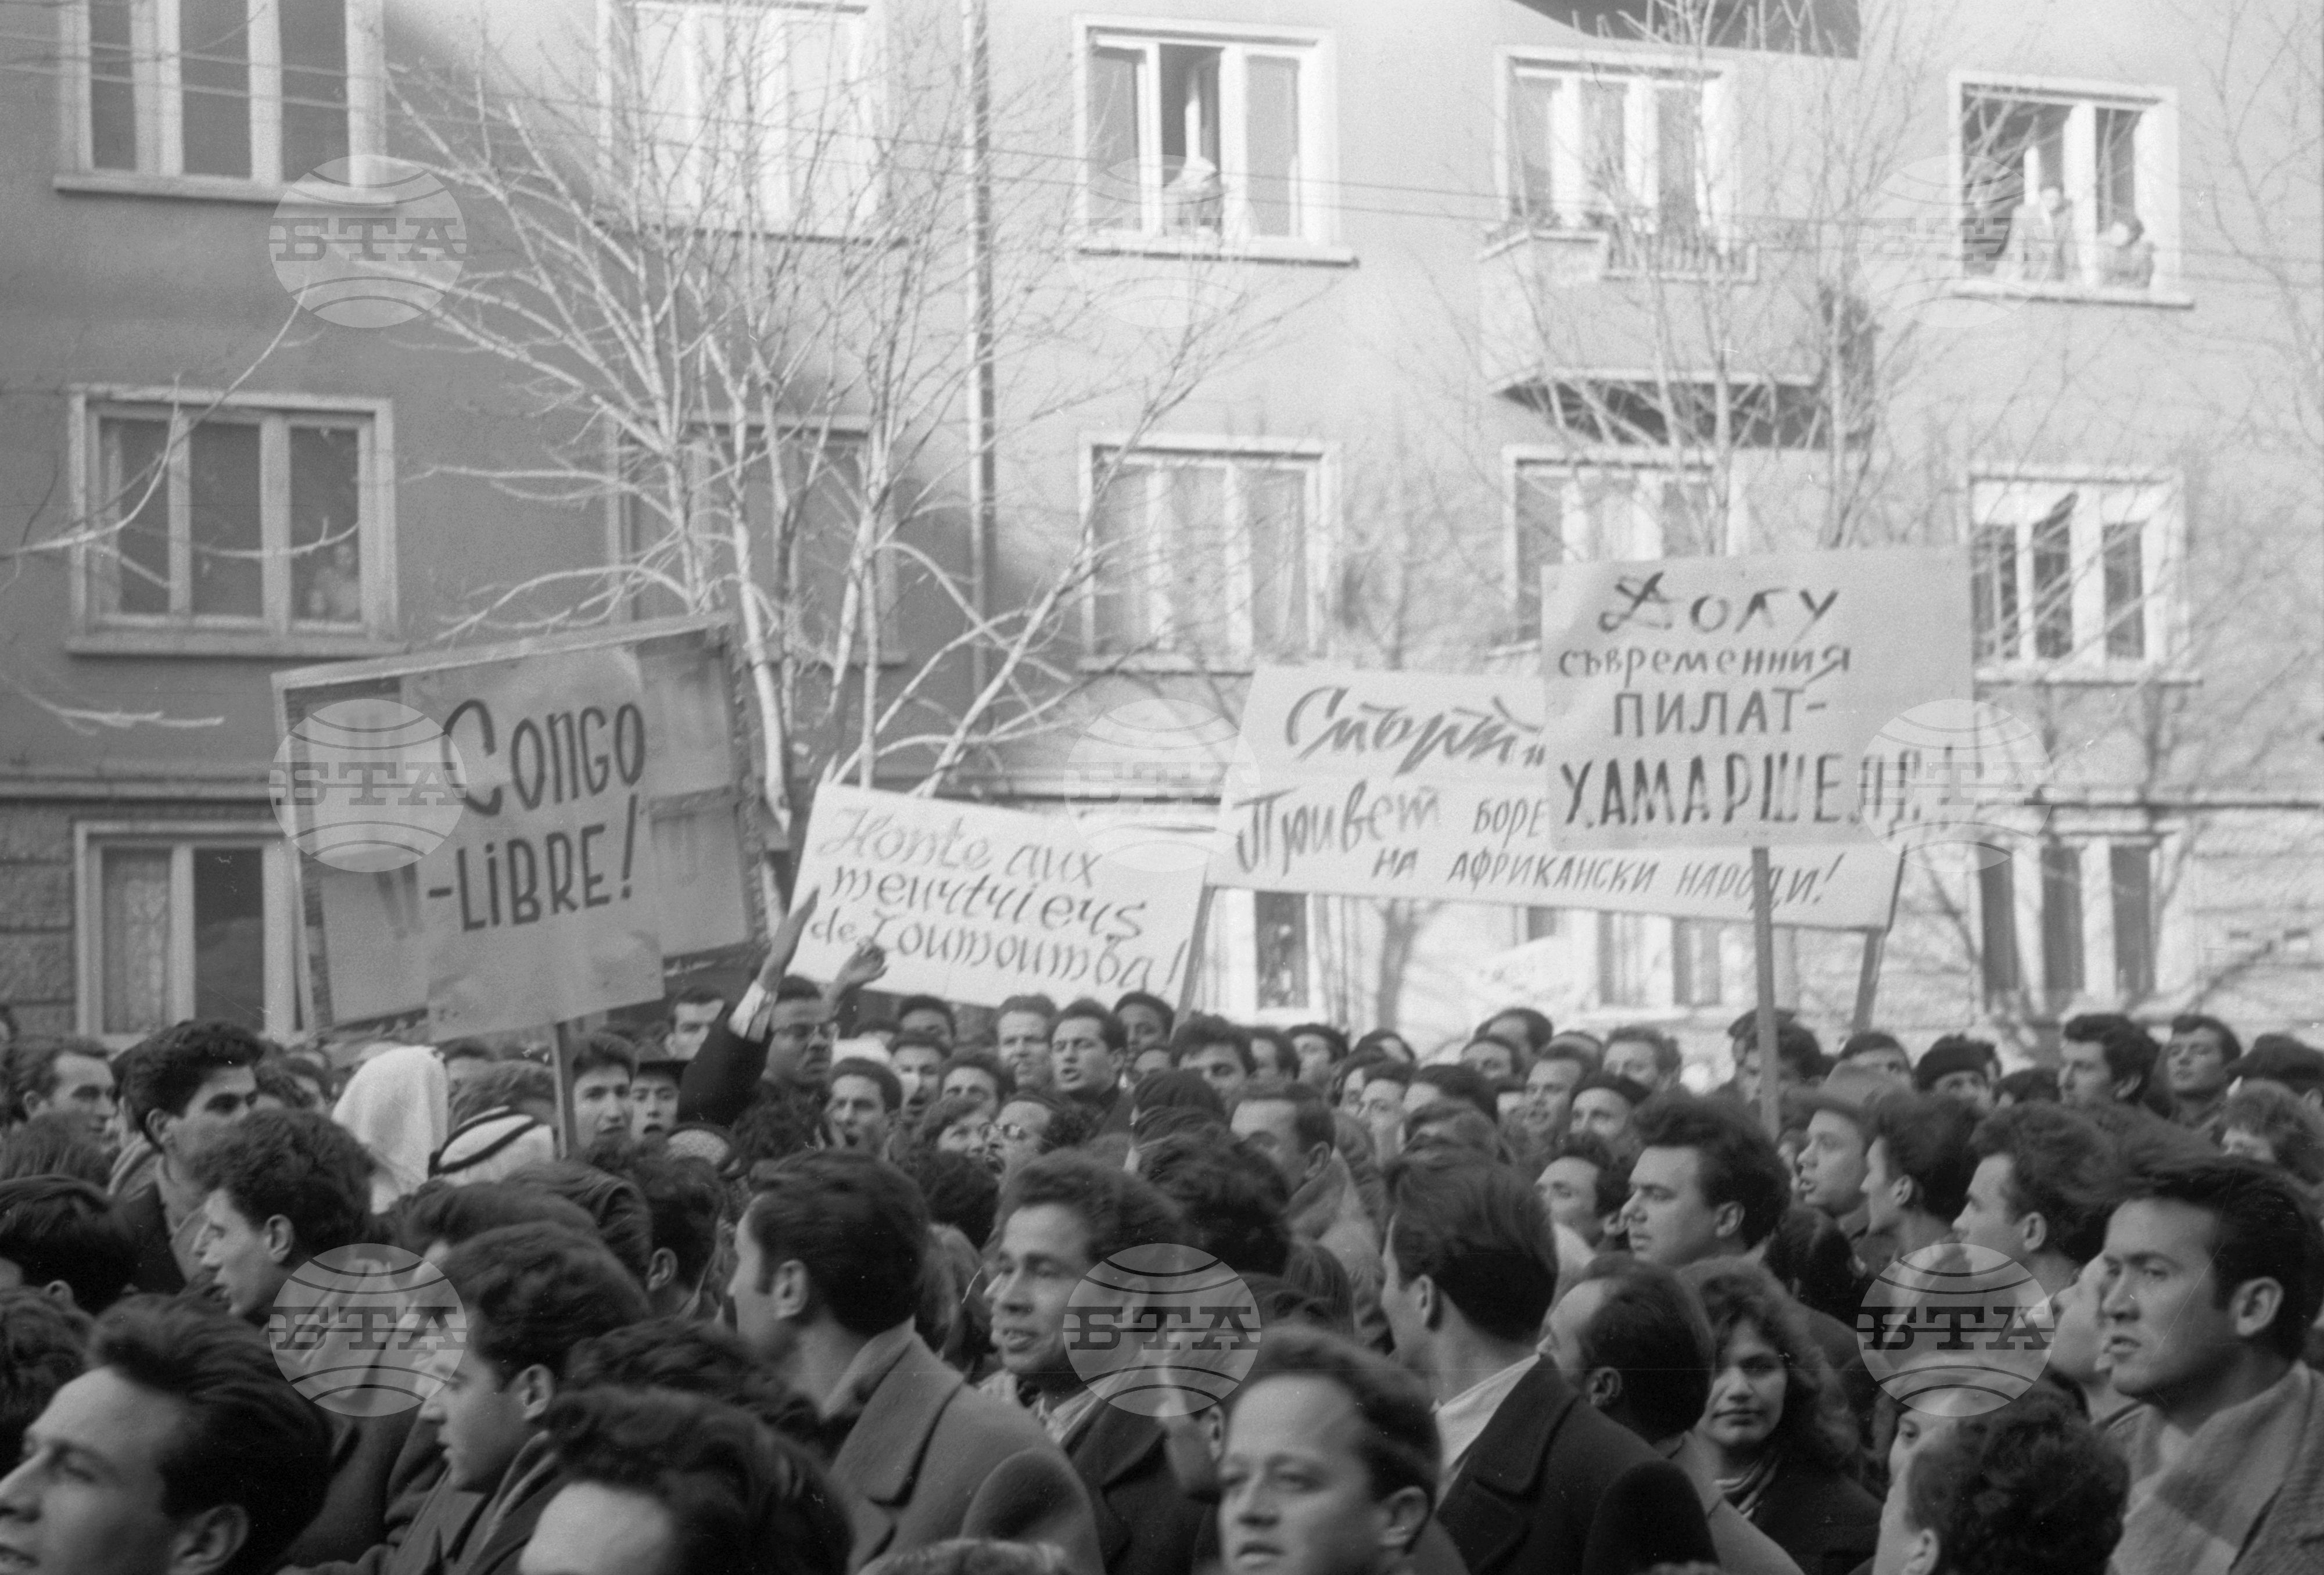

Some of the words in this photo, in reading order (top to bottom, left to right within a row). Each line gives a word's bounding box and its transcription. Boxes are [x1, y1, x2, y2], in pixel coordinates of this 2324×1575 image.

[818, 807, 991, 870] Honte
[1005, 843, 1103, 888] aux
[810, 907, 856, 943] de
